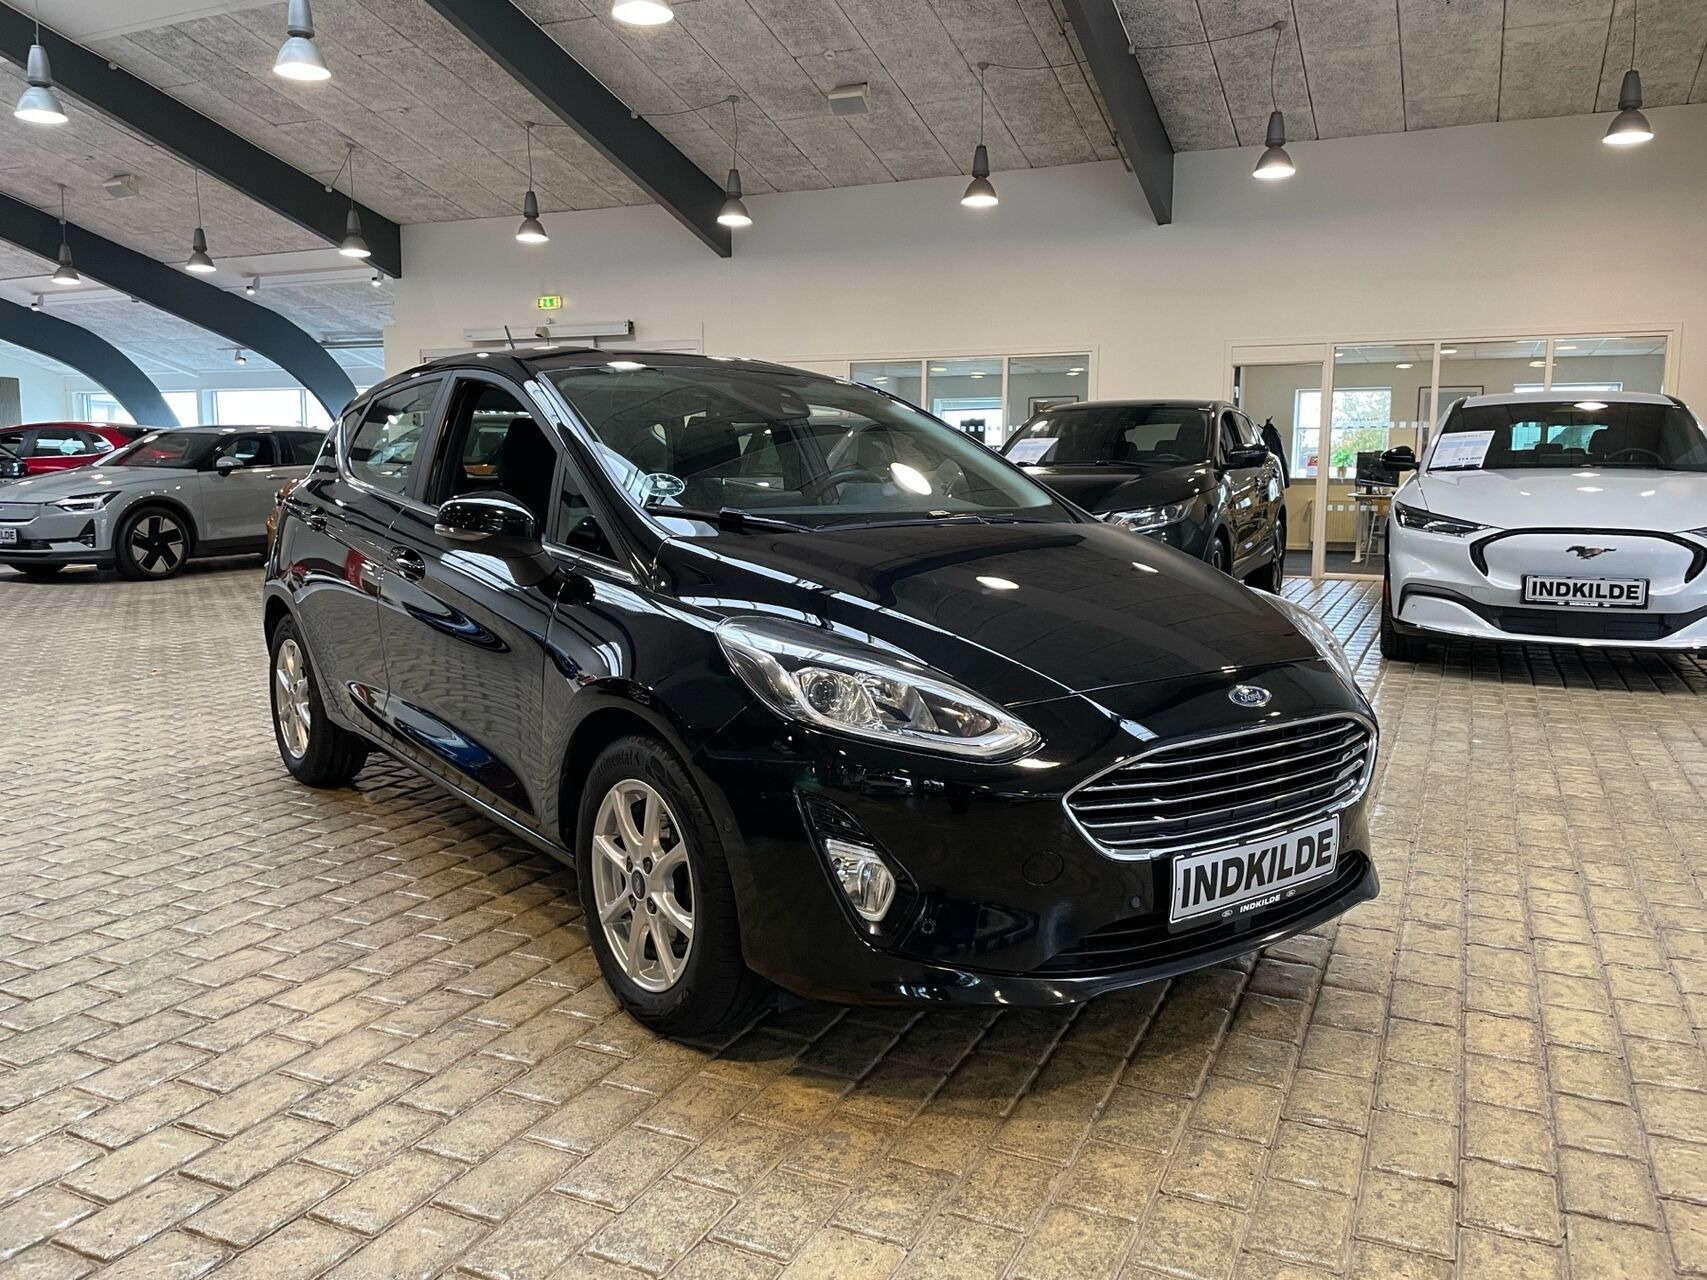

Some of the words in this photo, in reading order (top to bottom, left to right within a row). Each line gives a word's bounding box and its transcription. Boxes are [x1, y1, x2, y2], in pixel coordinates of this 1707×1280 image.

[0, 530, 15, 540] LDE
[1531, 581, 1640, 600] INDKILDE
[1240, 690, 1263, 703] Ford
[1181, 827, 1333, 909] INDKILDE
[1240, 894, 1281, 913] INDKILDE
